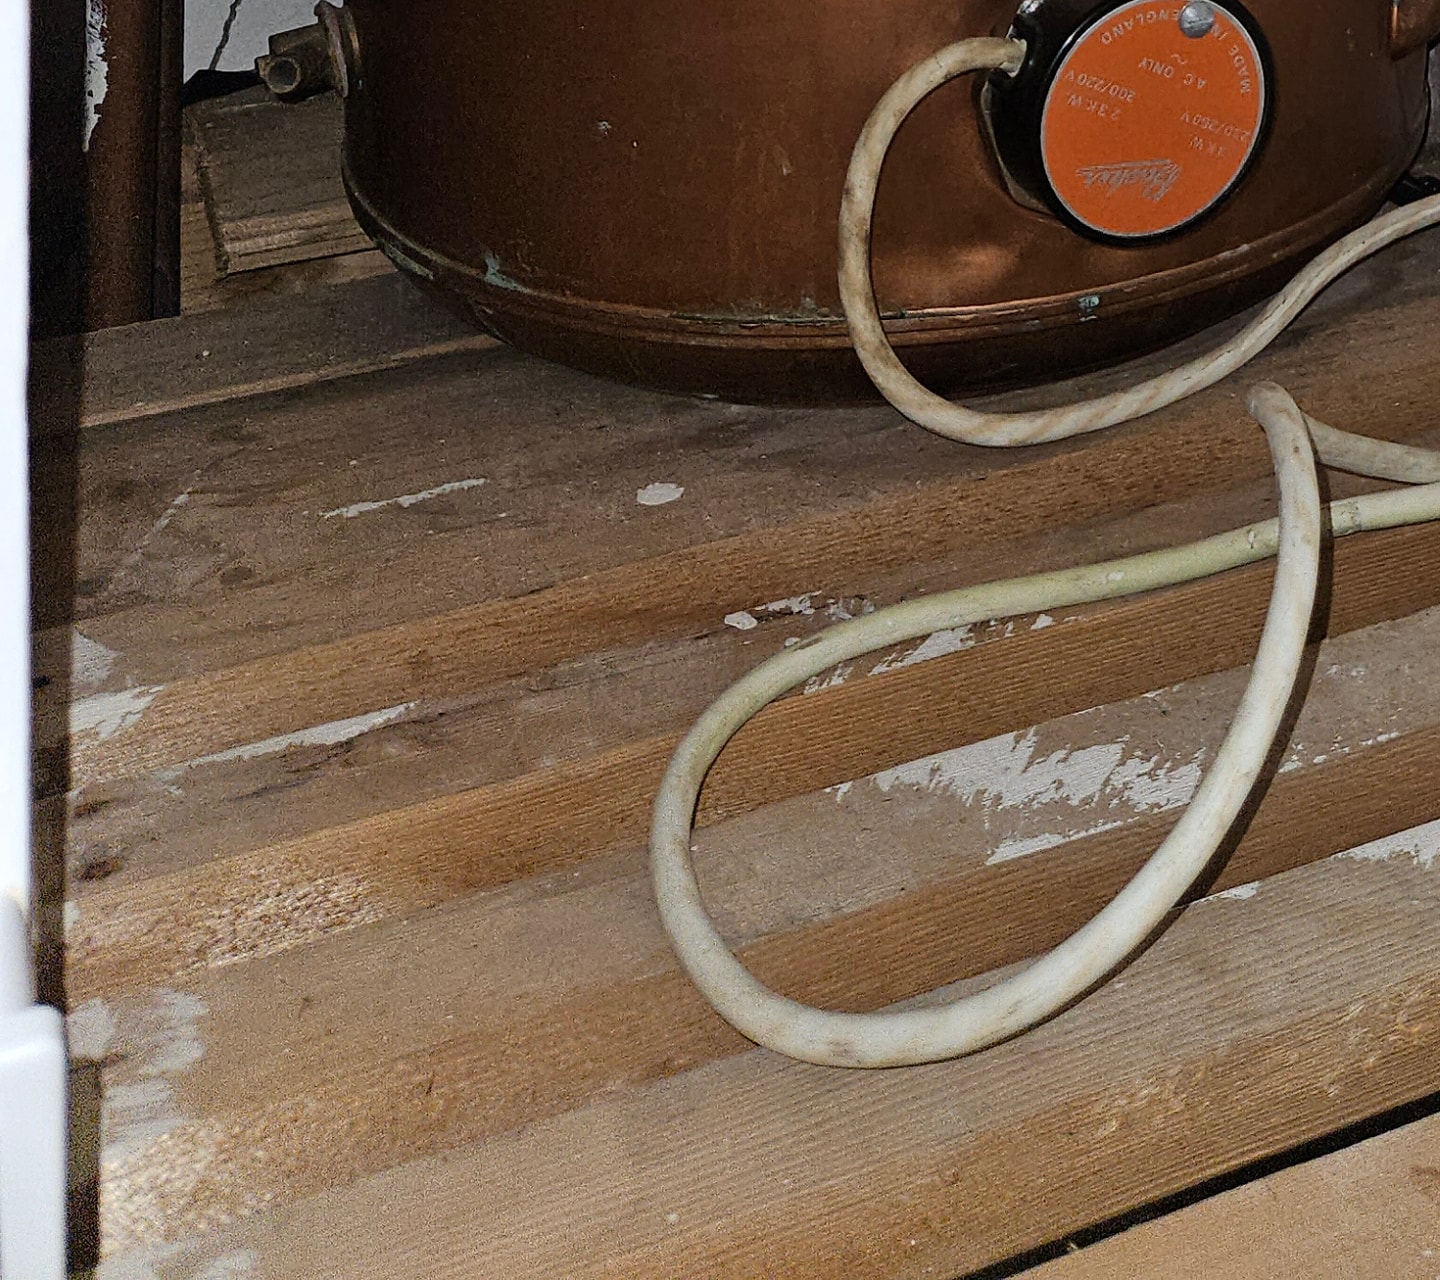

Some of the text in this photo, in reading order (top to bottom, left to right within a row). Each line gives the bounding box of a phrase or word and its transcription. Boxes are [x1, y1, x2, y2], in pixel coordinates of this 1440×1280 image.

[1100, 7, 1252, 94] MADE IN ENGLAND
[1138, 56, 1175, 78] ONLY
